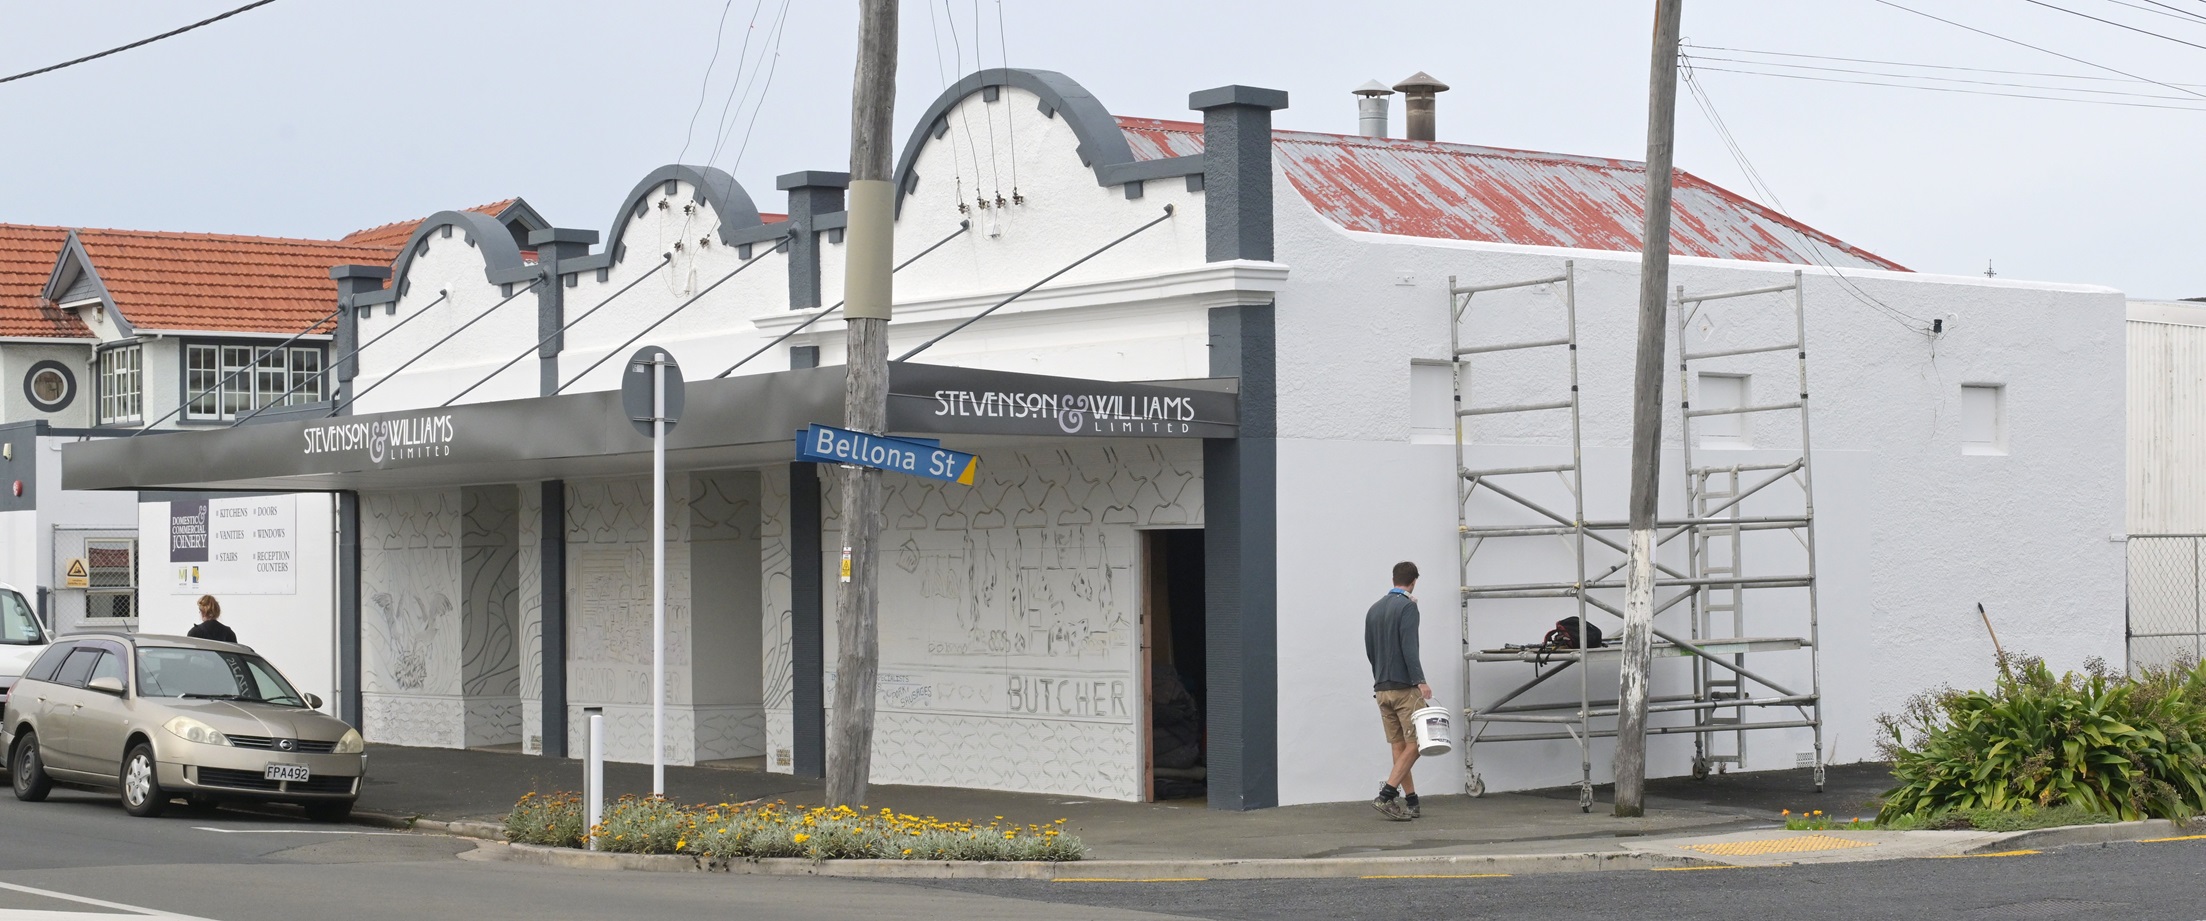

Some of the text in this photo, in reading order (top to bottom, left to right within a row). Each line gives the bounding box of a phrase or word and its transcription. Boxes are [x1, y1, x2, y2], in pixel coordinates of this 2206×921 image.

[934, 390, 1195, 434] STEVENSON & WILLIAMS
[1094, 421, 1190, 434] LIMITED
[303, 415, 454, 464] STEVENSON & WILLIAMS
[390, 445, 450, 460] LIMITED
[816, 428, 956, 478] Bellona St
[219, 508, 248, 517] KITCHENS
[257, 507, 277, 516] DOORS
[172, 516, 199, 525] DOMESTIC
[172, 525, 206, 534] COMMERCIAL
[257, 529, 285, 538] WINDOWS
[219, 530, 244, 539] VANITIES
[172, 534, 207, 552] JOINERY
[219, 553, 238, 561] STAIRS
[257, 552, 290, 560] RECEPTION
[257, 563, 288, 572] COUNTERS
[877, 674, 909, 682] PECIALISTS
[1007, 675, 1127, 717] BUTCHER
[266, 766, 307, 779] FPA492
